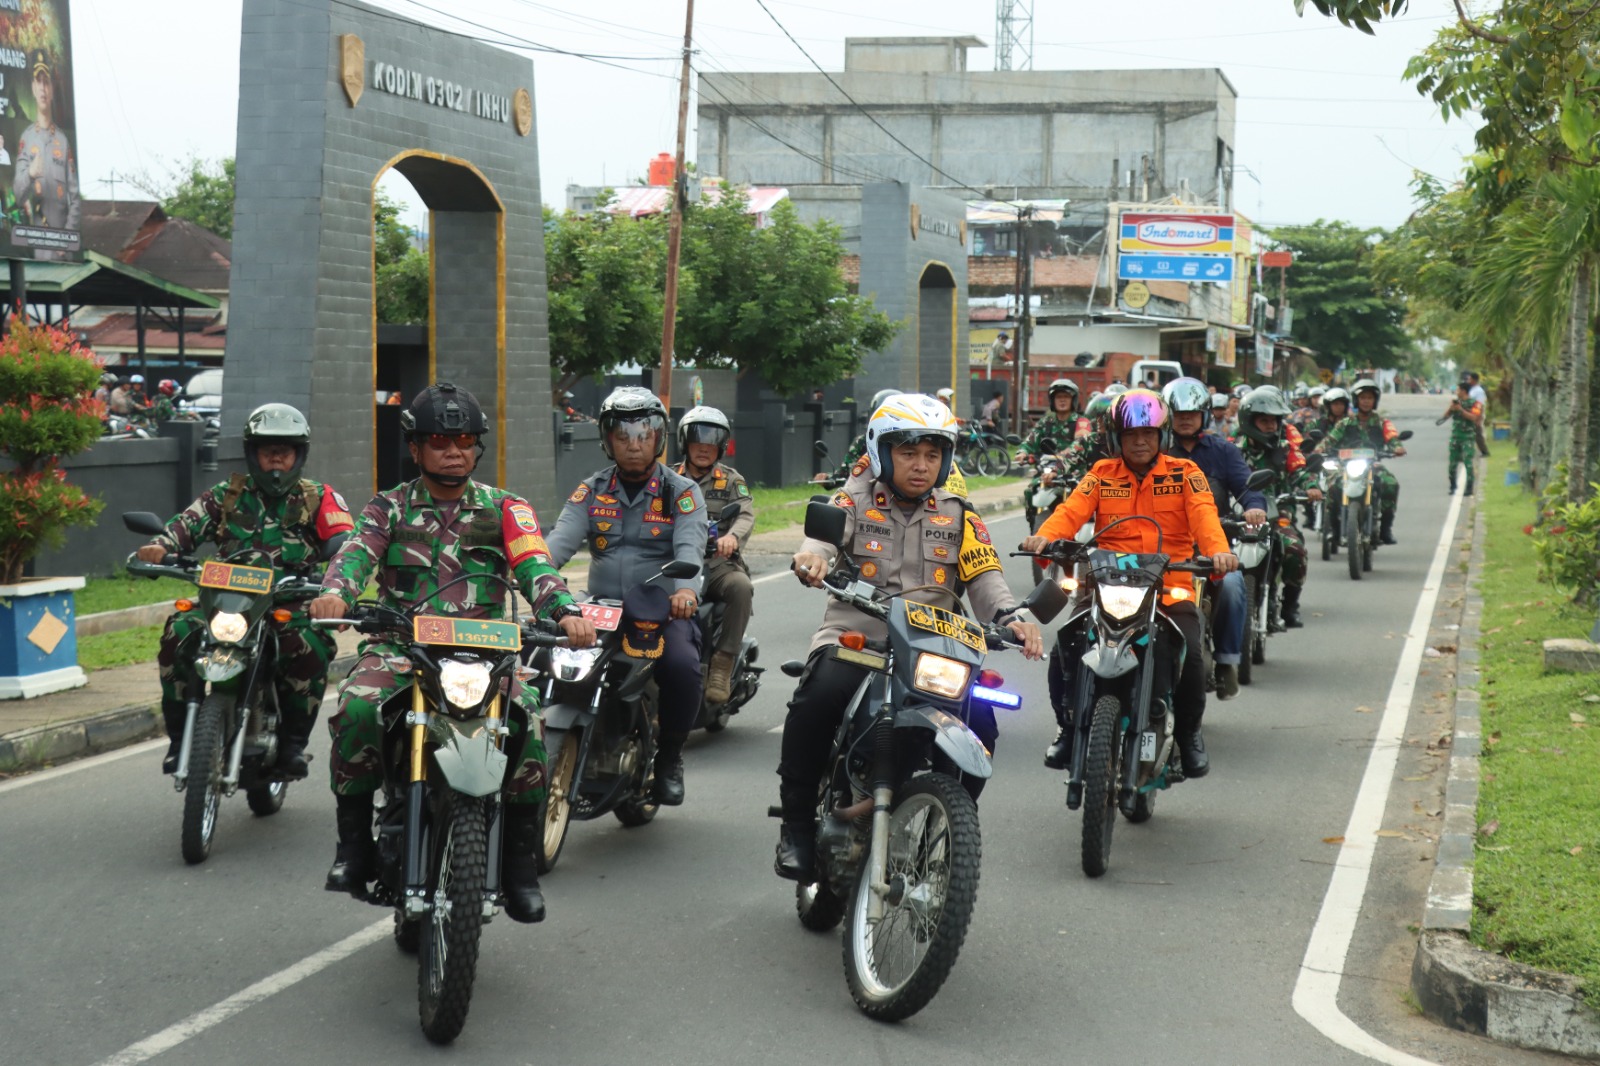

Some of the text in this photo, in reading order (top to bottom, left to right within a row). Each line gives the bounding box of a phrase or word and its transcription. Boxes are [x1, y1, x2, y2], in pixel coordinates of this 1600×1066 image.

[374, 62, 422, 100] KODIM
[426, 76, 463, 111] 0302
[476, 90, 510, 123] INHU
[1142, 224, 1213, 239] Indomaret
[1101, 489, 1129, 497] MULYADI
[593, 508, 617, 516] AGUS
[925, 529, 958, 542] POLRI
[961, 547, 991, 565] WAKA
[972, 557, 990, 568] OMP
[938, 622, 985, 650] 10012-30
